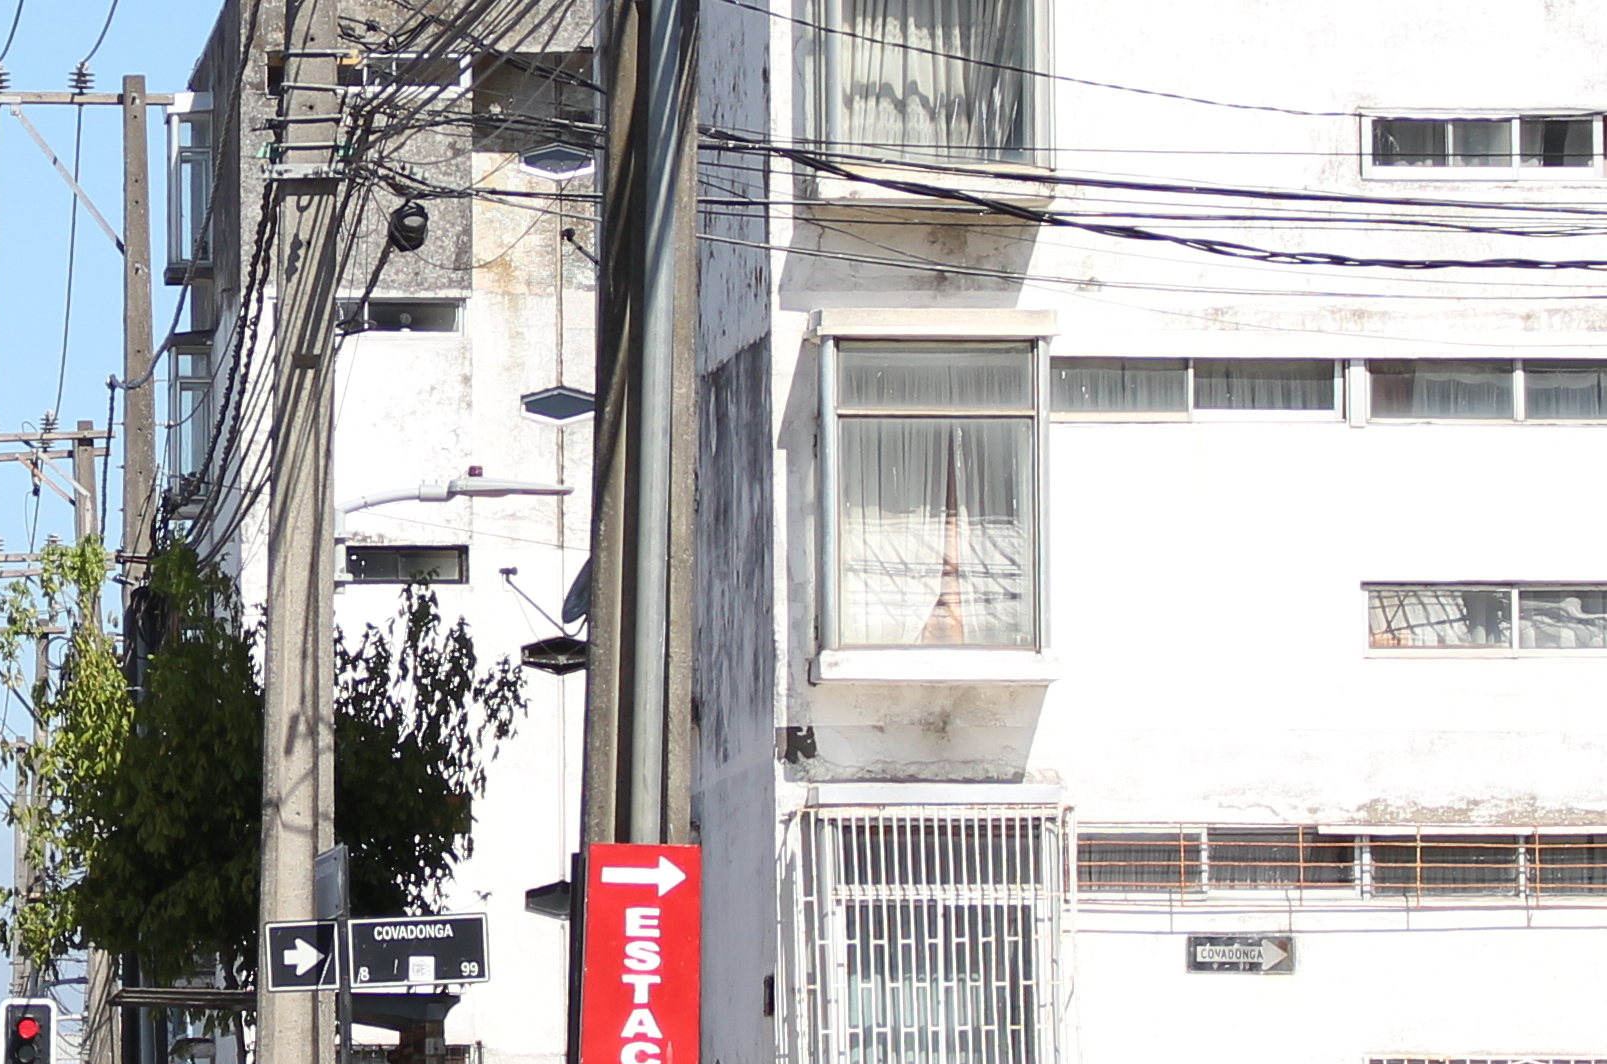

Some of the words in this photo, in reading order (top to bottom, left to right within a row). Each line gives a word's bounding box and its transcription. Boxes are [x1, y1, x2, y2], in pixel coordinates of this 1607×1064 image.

[373, 924, 454, 941] COVADONGA
[1200, 948, 1264, 960] COVADONGA
[460, 961, 480, 977] 99
